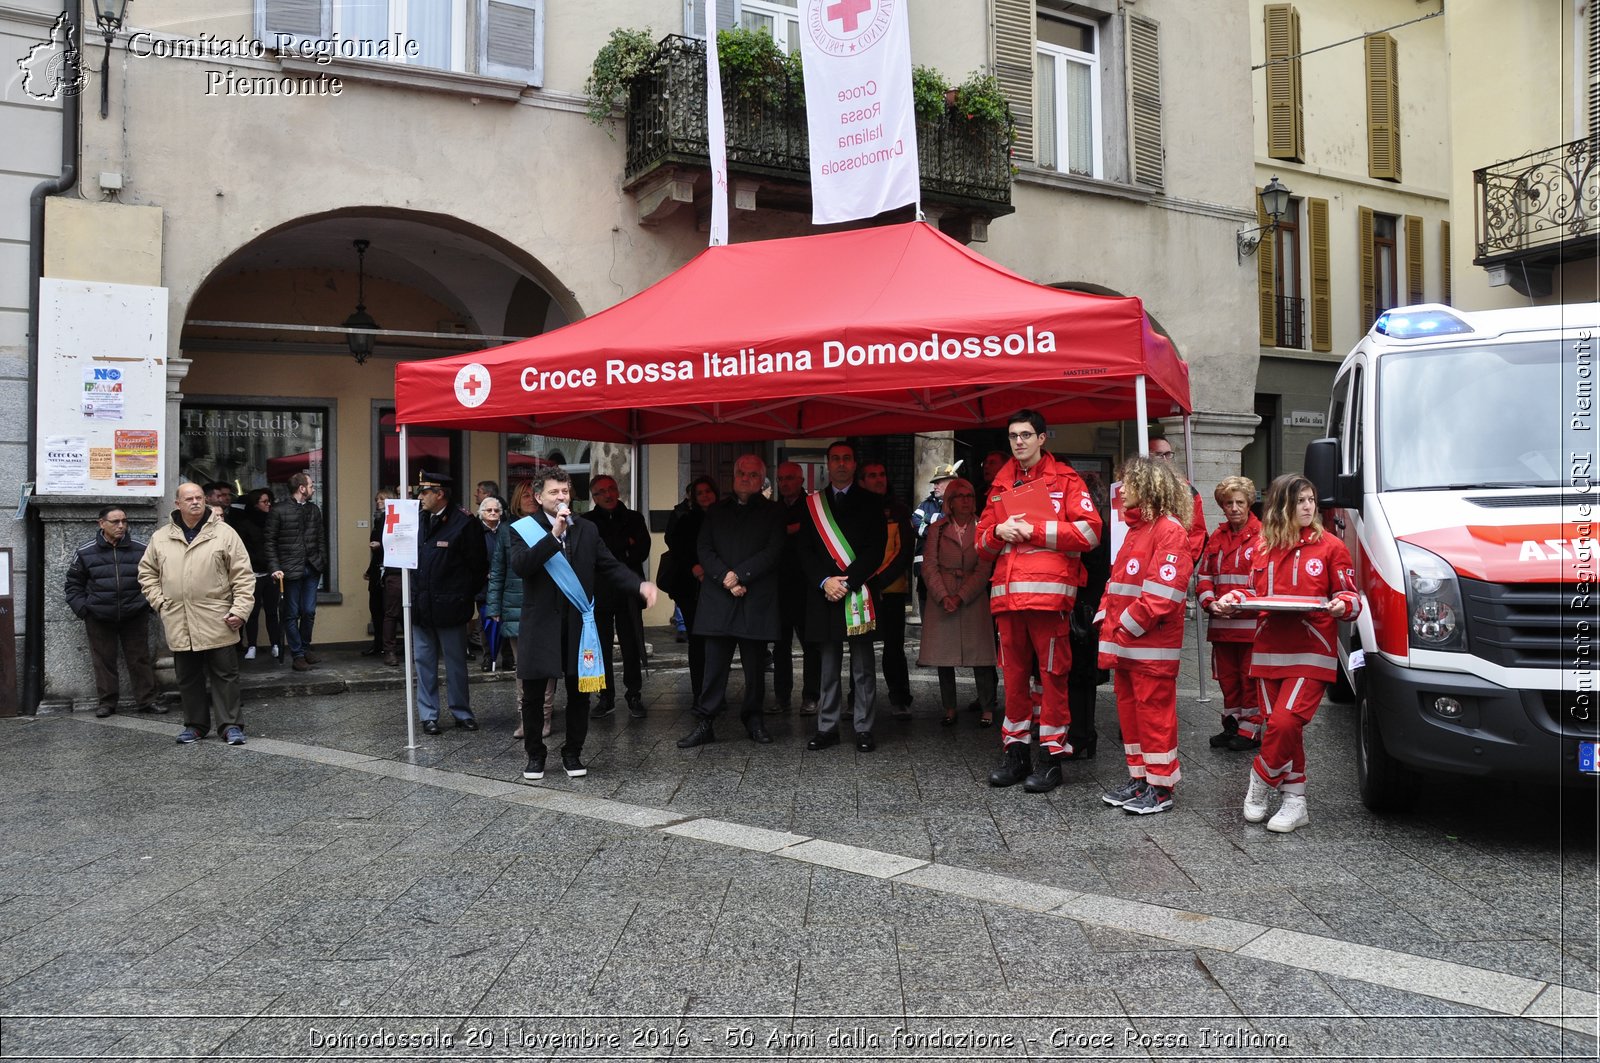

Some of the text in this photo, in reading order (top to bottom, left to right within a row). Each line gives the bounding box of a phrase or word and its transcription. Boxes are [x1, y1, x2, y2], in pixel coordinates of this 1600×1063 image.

[520, 366, 597, 393] Croce
[605, 358, 694, 386] Rossa
[702, 347, 812, 379] Italiana
[822, 325, 1057, 369] Domodossola
[93, 368, 121, 381] NO
[185, 413, 300, 431] Hair Studio
[184, 430, 299, 439] acconciature unisex
[1583, 759, 1590, 767] D
